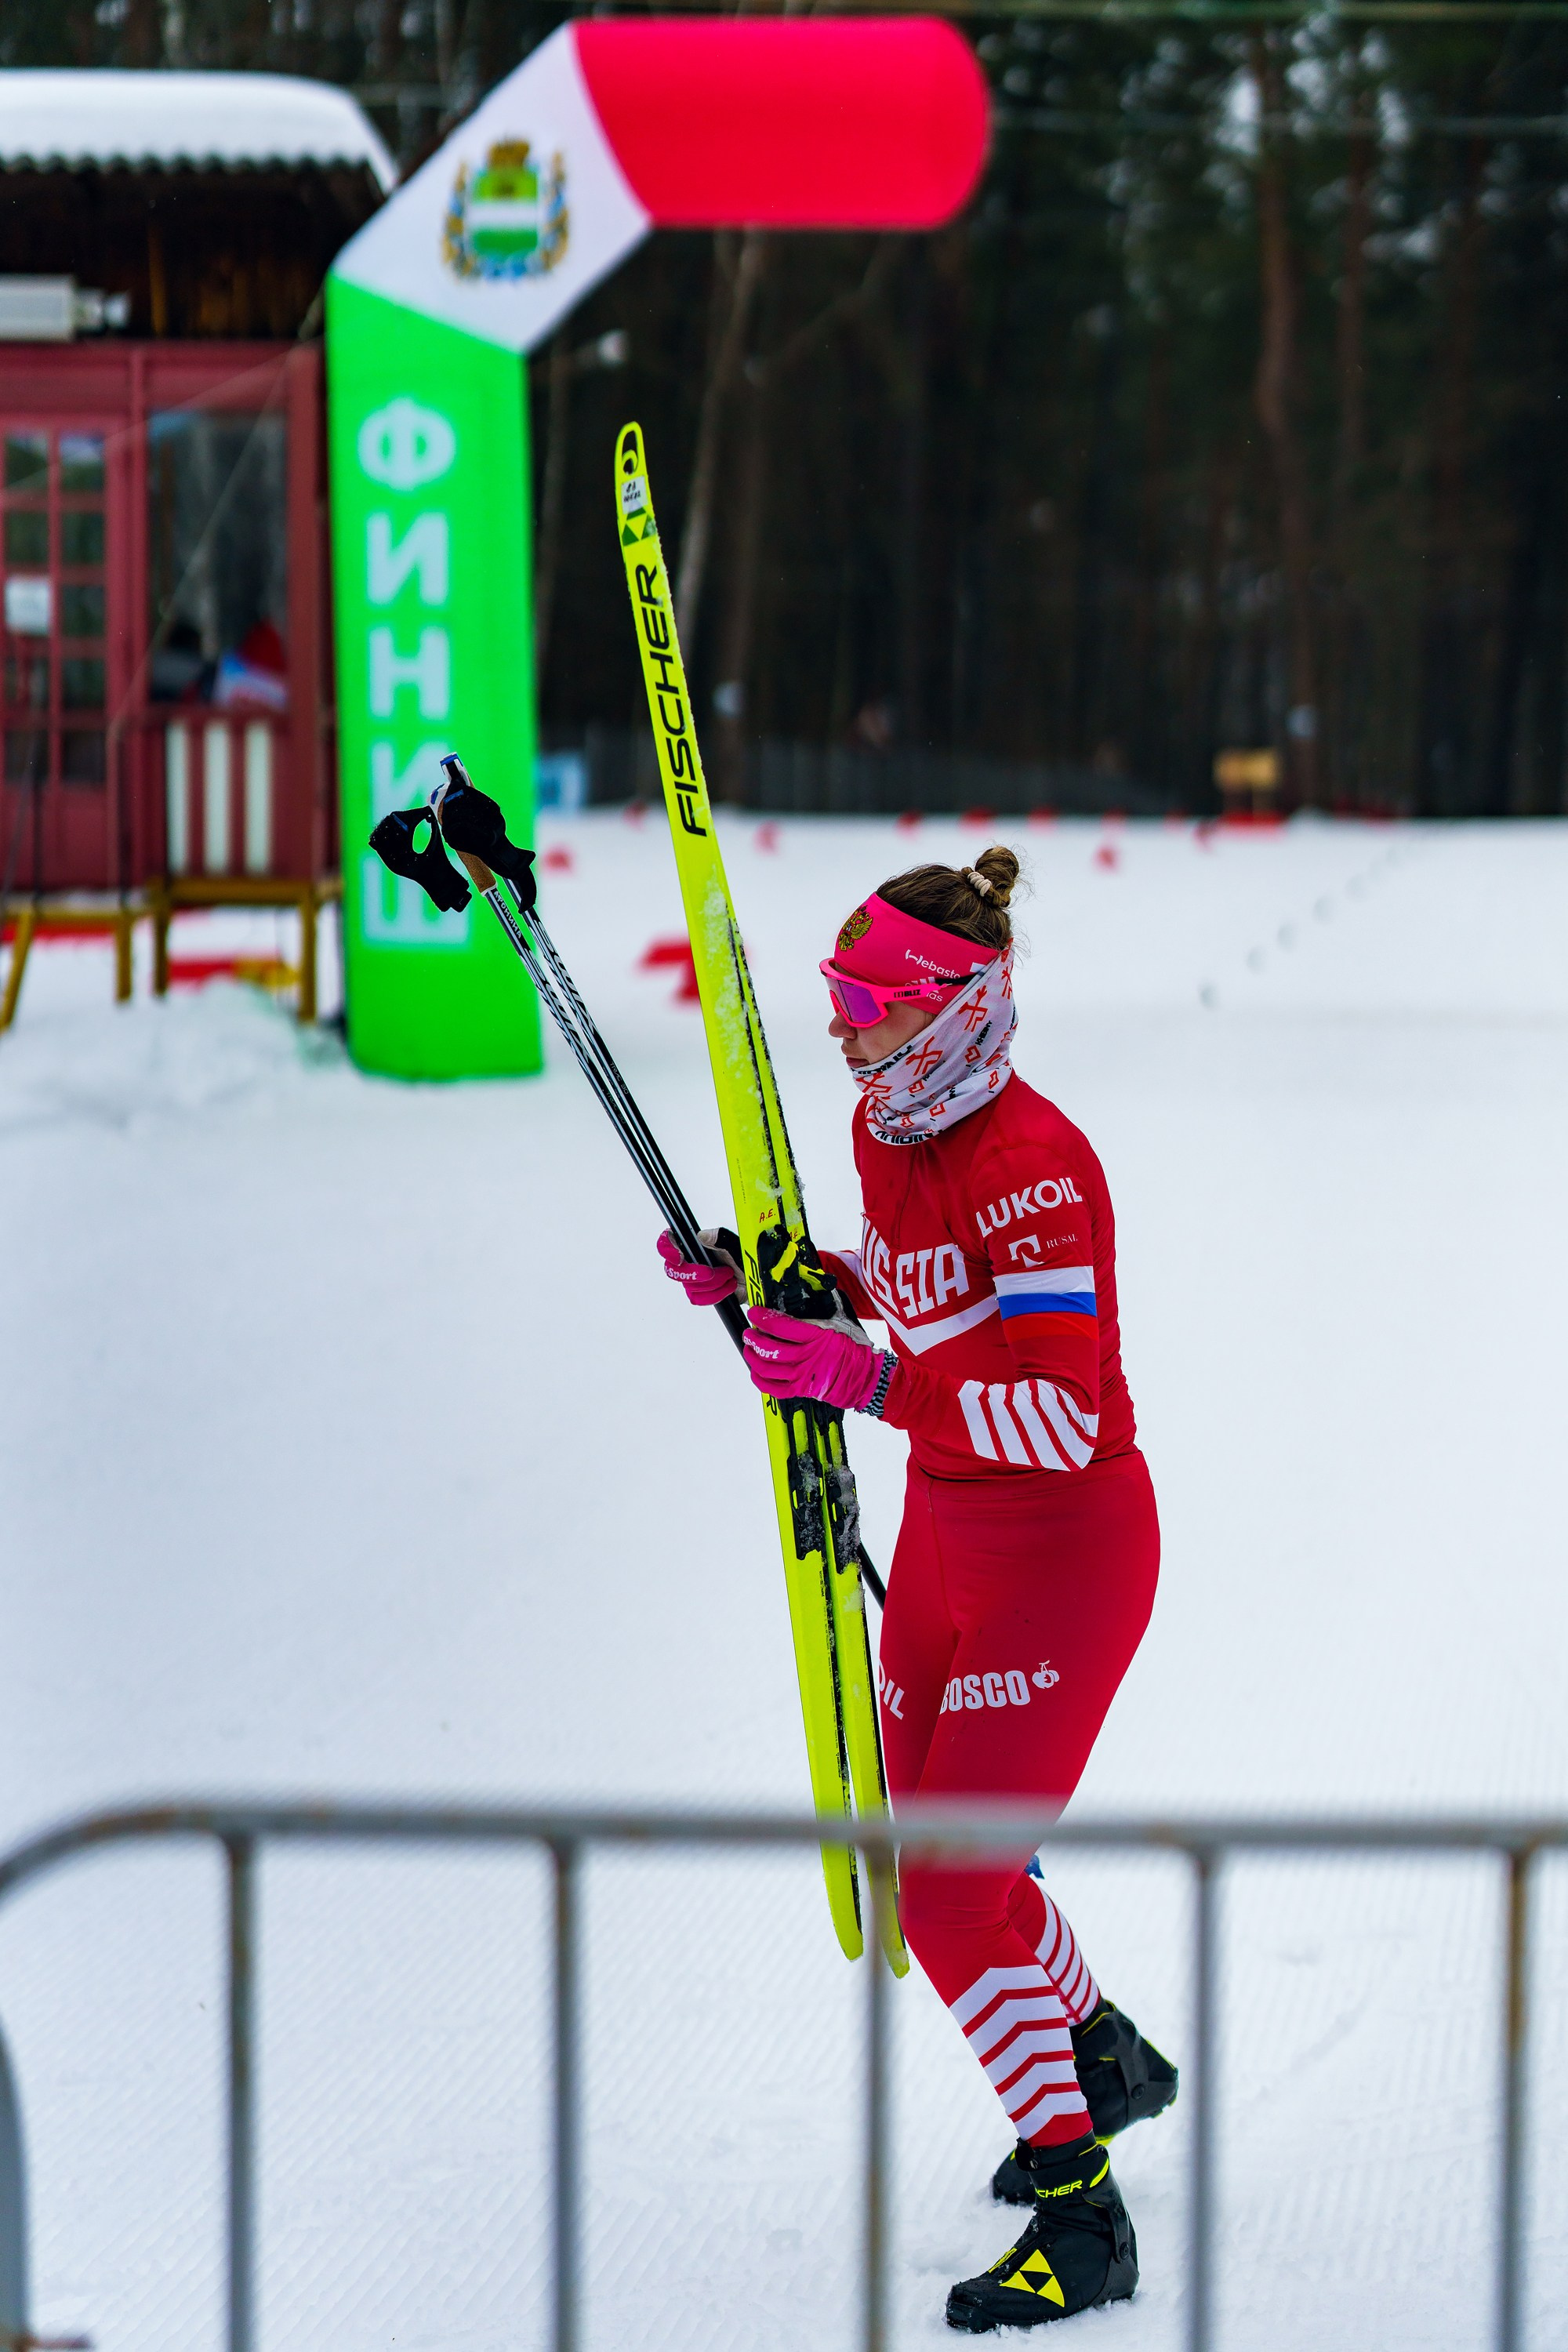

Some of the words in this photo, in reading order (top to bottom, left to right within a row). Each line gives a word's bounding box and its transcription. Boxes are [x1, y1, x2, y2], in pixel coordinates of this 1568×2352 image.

[358, 398, 470, 945] ФИНИШ
[636, 564, 707, 837] FISCHER
[976, 1177, 1083, 1238] LUKOIL
[1046, 1233, 1078, 1249] RUSAL
[861, 1215, 969, 1319] USSIA
[1035, 2180, 1083, 2198] CHER
